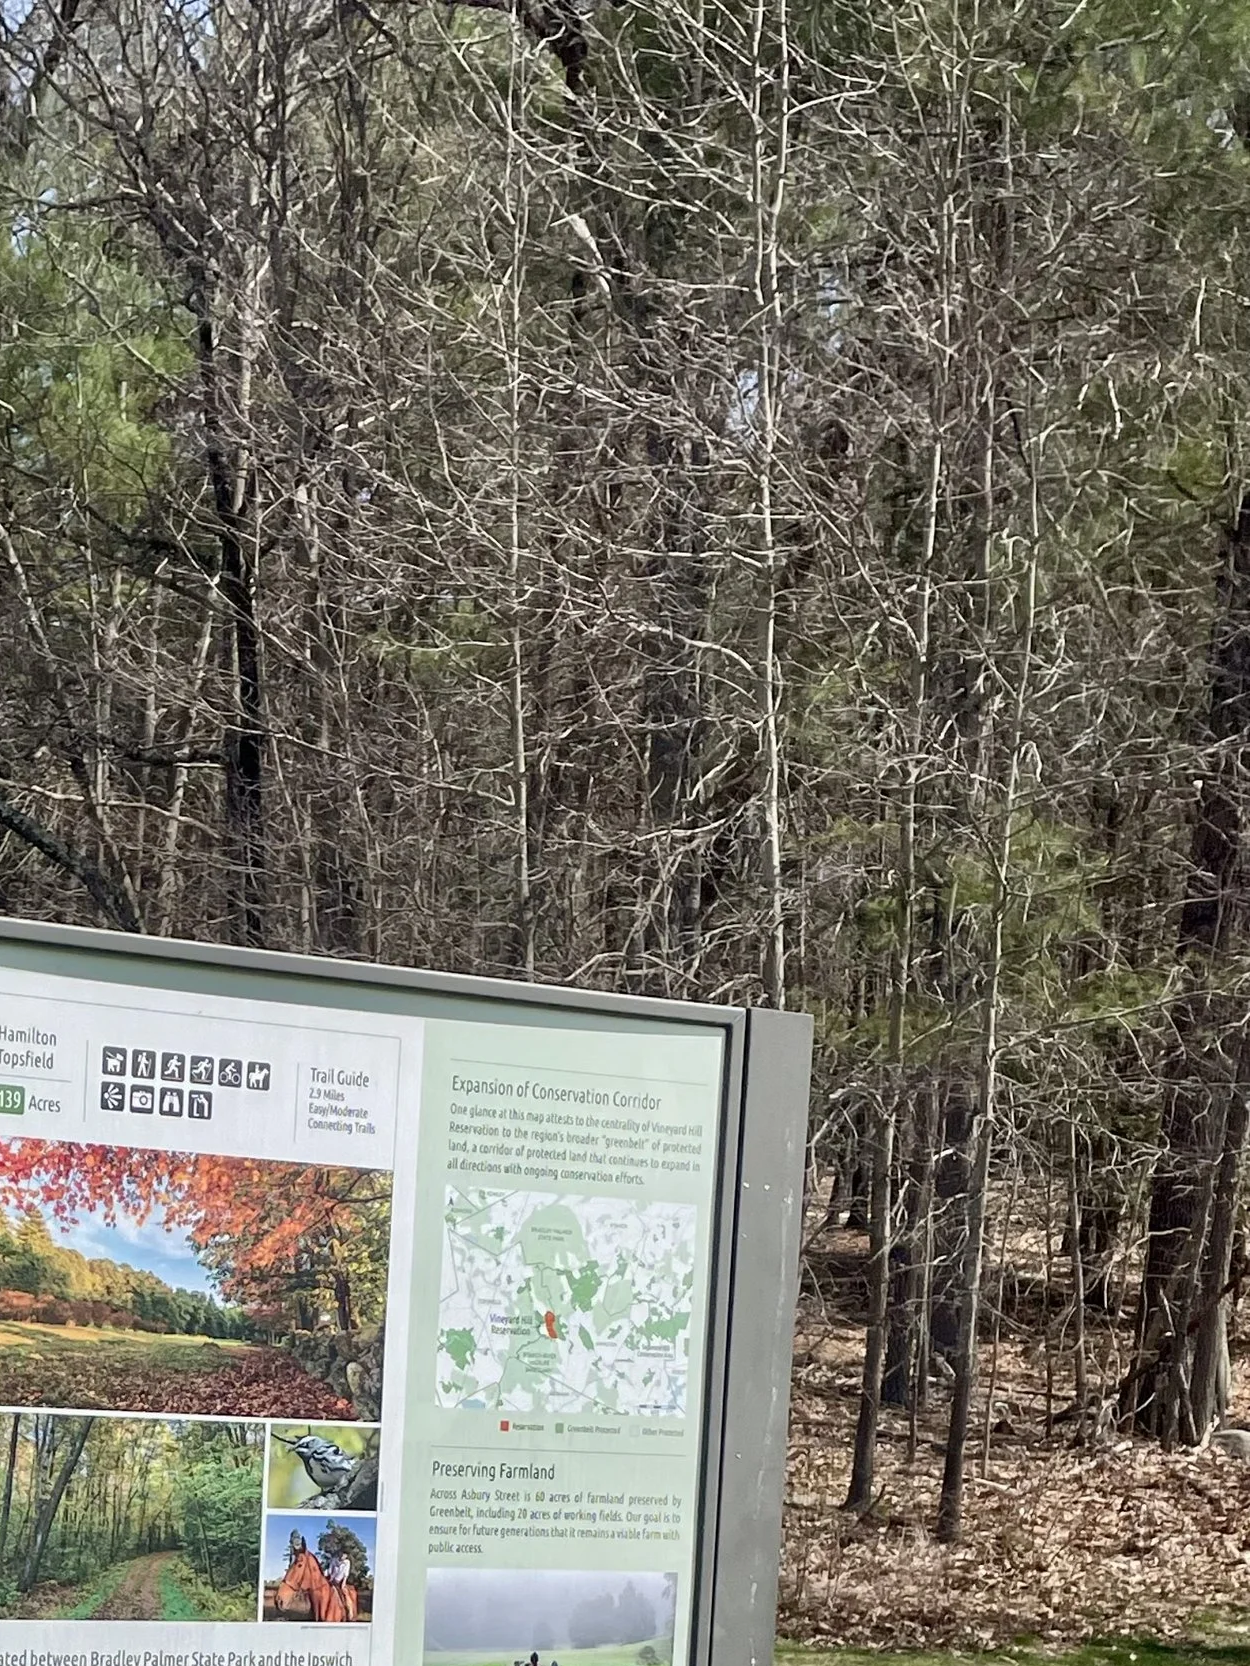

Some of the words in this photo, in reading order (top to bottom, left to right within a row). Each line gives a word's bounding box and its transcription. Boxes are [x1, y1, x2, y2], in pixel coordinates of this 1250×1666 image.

[310, 1067, 335, 1084] Trail
[337, 1069, 370, 1087] Guide
[309, 1087, 322, 1099] 2.9
[323, 1088, 345, 1101] Miles
[452, 1074, 514, 1096] Expansion
[516, 1081, 530, 1097] of
[532, 1082, 609, 1105] Conservation
[613, 1090, 662, 1110] Corridor
[28, 1094, 61, 1112] Acres
[432, 1460, 496, 1481] Preserving
[500, 1462, 555, 1480] Farmland
[30, 1649, 87, 1666] between
[143, 1649, 190, 1666] Palmer
[191, 1651, 225, 1666] State
[227, 1650, 256, 1666] Park
[258, 1650, 282, 1666] and
[284, 1650, 305, 1666] the
